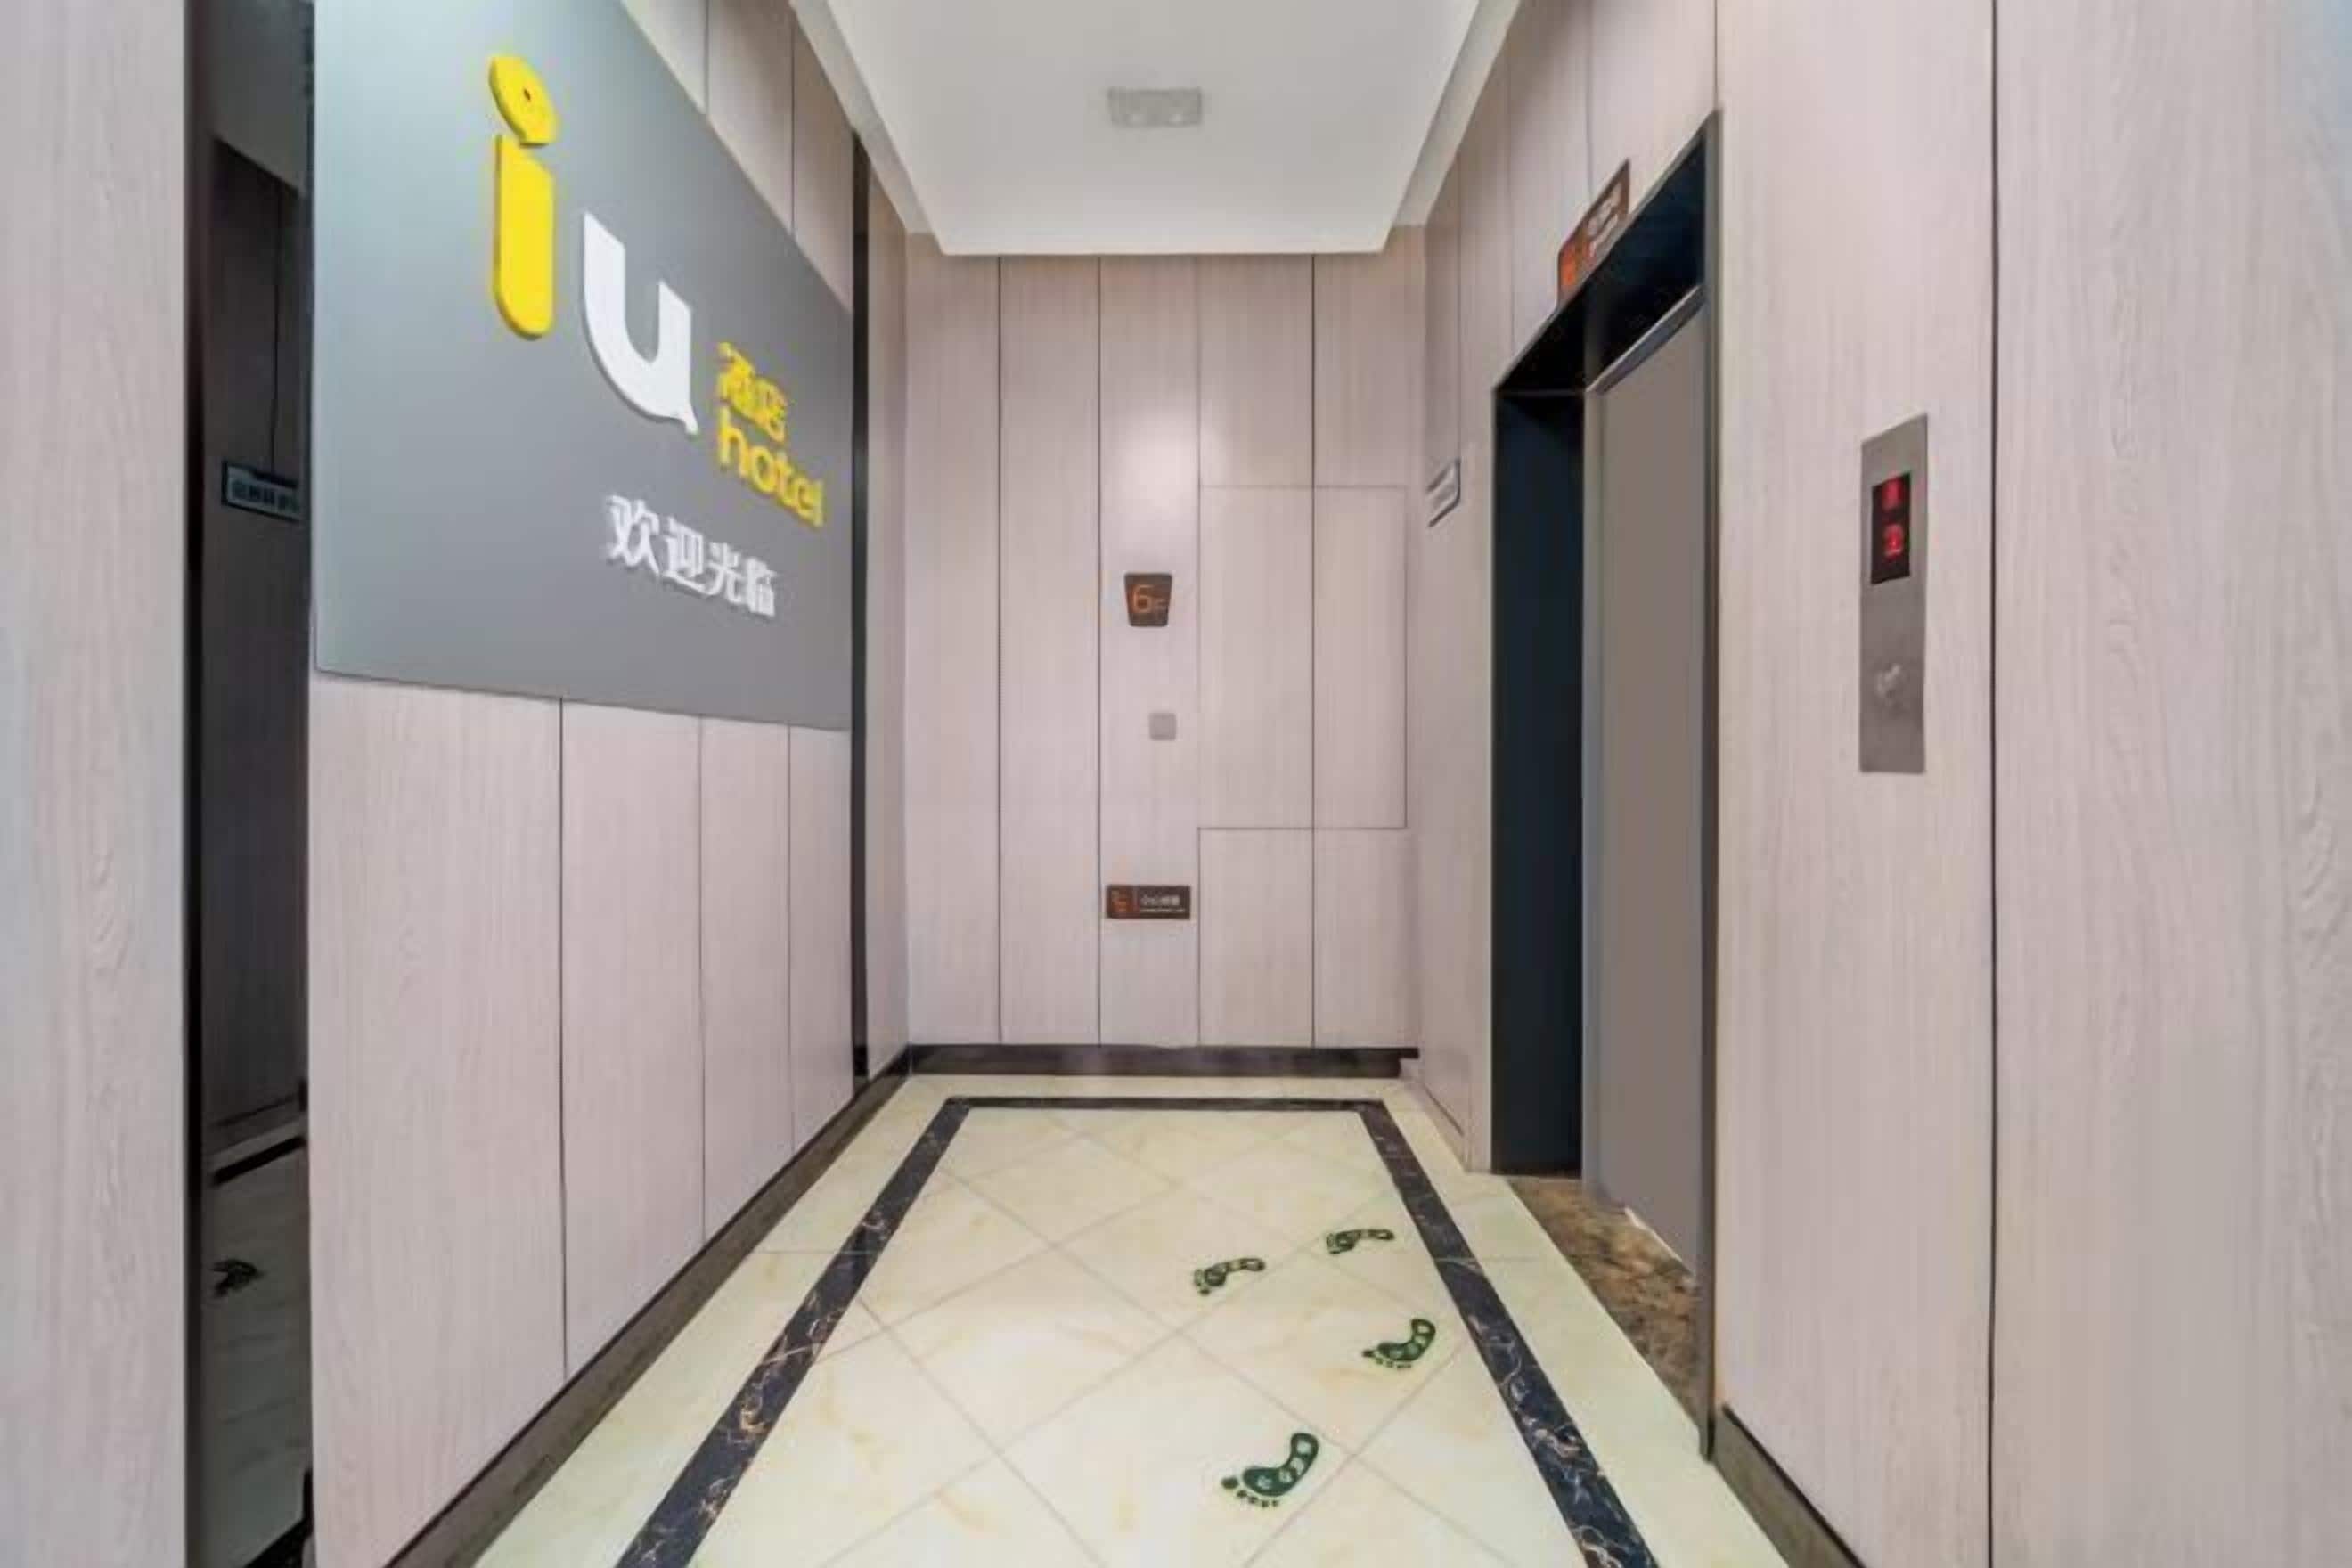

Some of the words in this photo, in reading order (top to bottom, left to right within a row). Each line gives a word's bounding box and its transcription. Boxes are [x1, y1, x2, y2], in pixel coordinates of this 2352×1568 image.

[718, 341, 788, 443] 酒店
[717, 404, 825, 529] hotel
[606, 494, 777, 617] 欢迎光临
